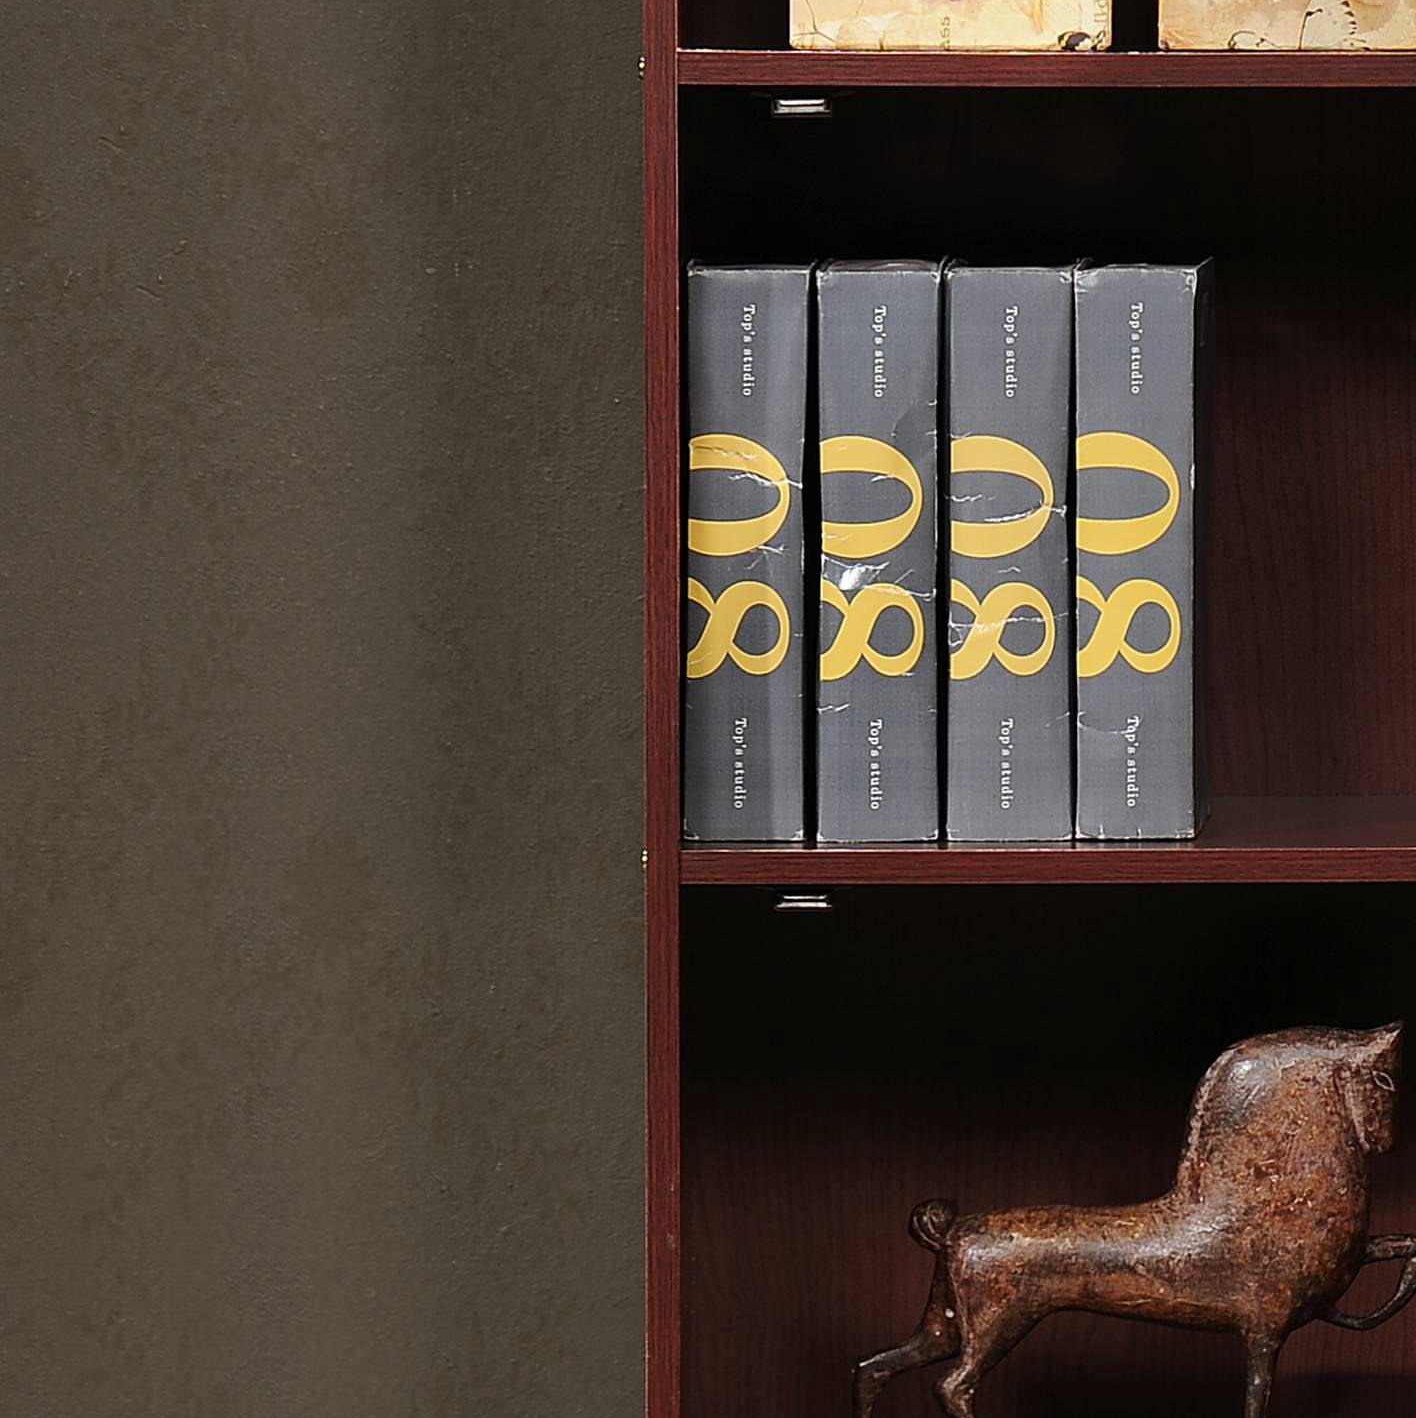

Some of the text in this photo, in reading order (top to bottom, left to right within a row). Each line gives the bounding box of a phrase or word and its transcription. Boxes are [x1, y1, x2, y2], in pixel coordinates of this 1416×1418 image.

[740, 304, 757, 396] Top's studio
[871, 305, 887, 398] Top's studio
[1003, 305, 1019, 398] Top's studio
[1128, 302, 1144, 395] Top's studio
[732, 717, 748, 809] Top's studio
[867, 718, 884, 810] Top's studio
[998, 717, 1014, 809] Top's studio
[1124, 715, 1142, 807] Top's studio
